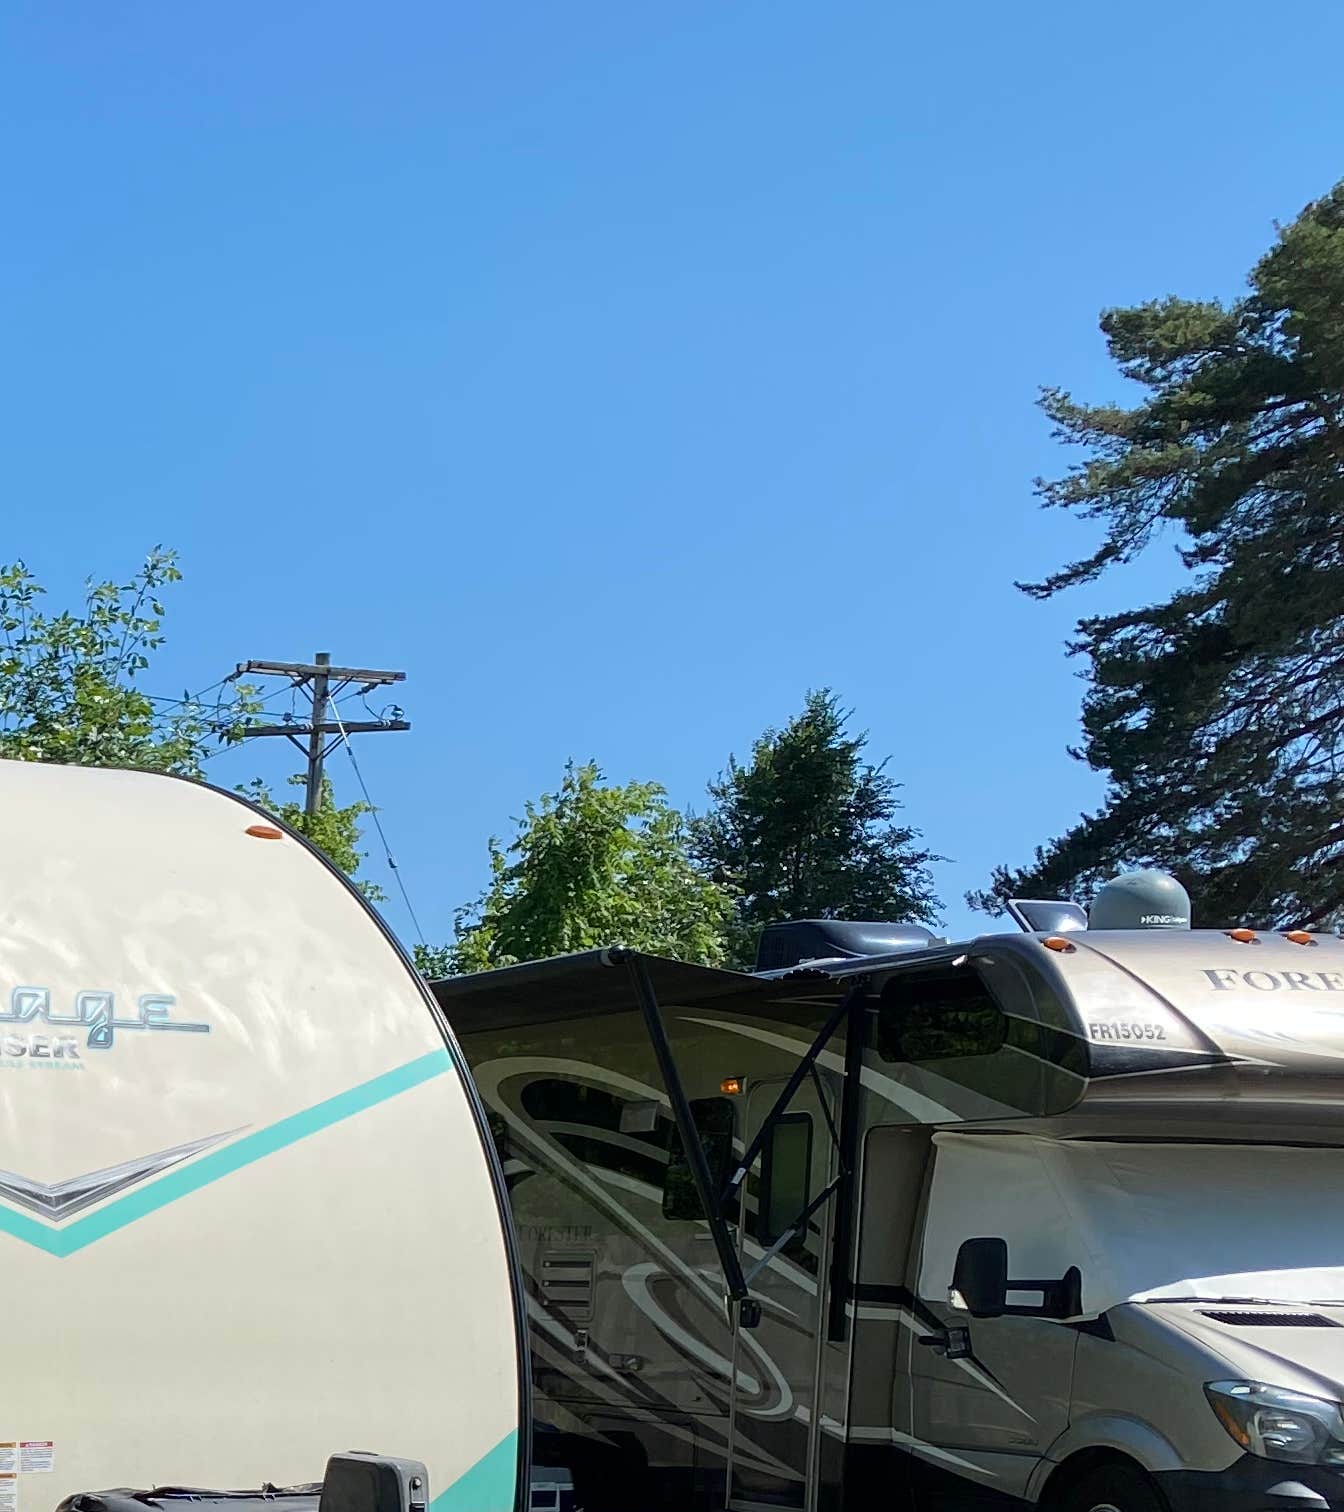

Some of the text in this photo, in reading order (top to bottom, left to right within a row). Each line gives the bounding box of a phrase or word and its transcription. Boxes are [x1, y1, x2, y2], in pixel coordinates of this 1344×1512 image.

[1146, 915, 1170, 924] KING
[1201, 968, 1344, 991] FORE
[1088, 1023, 1166, 1040] FR15052
